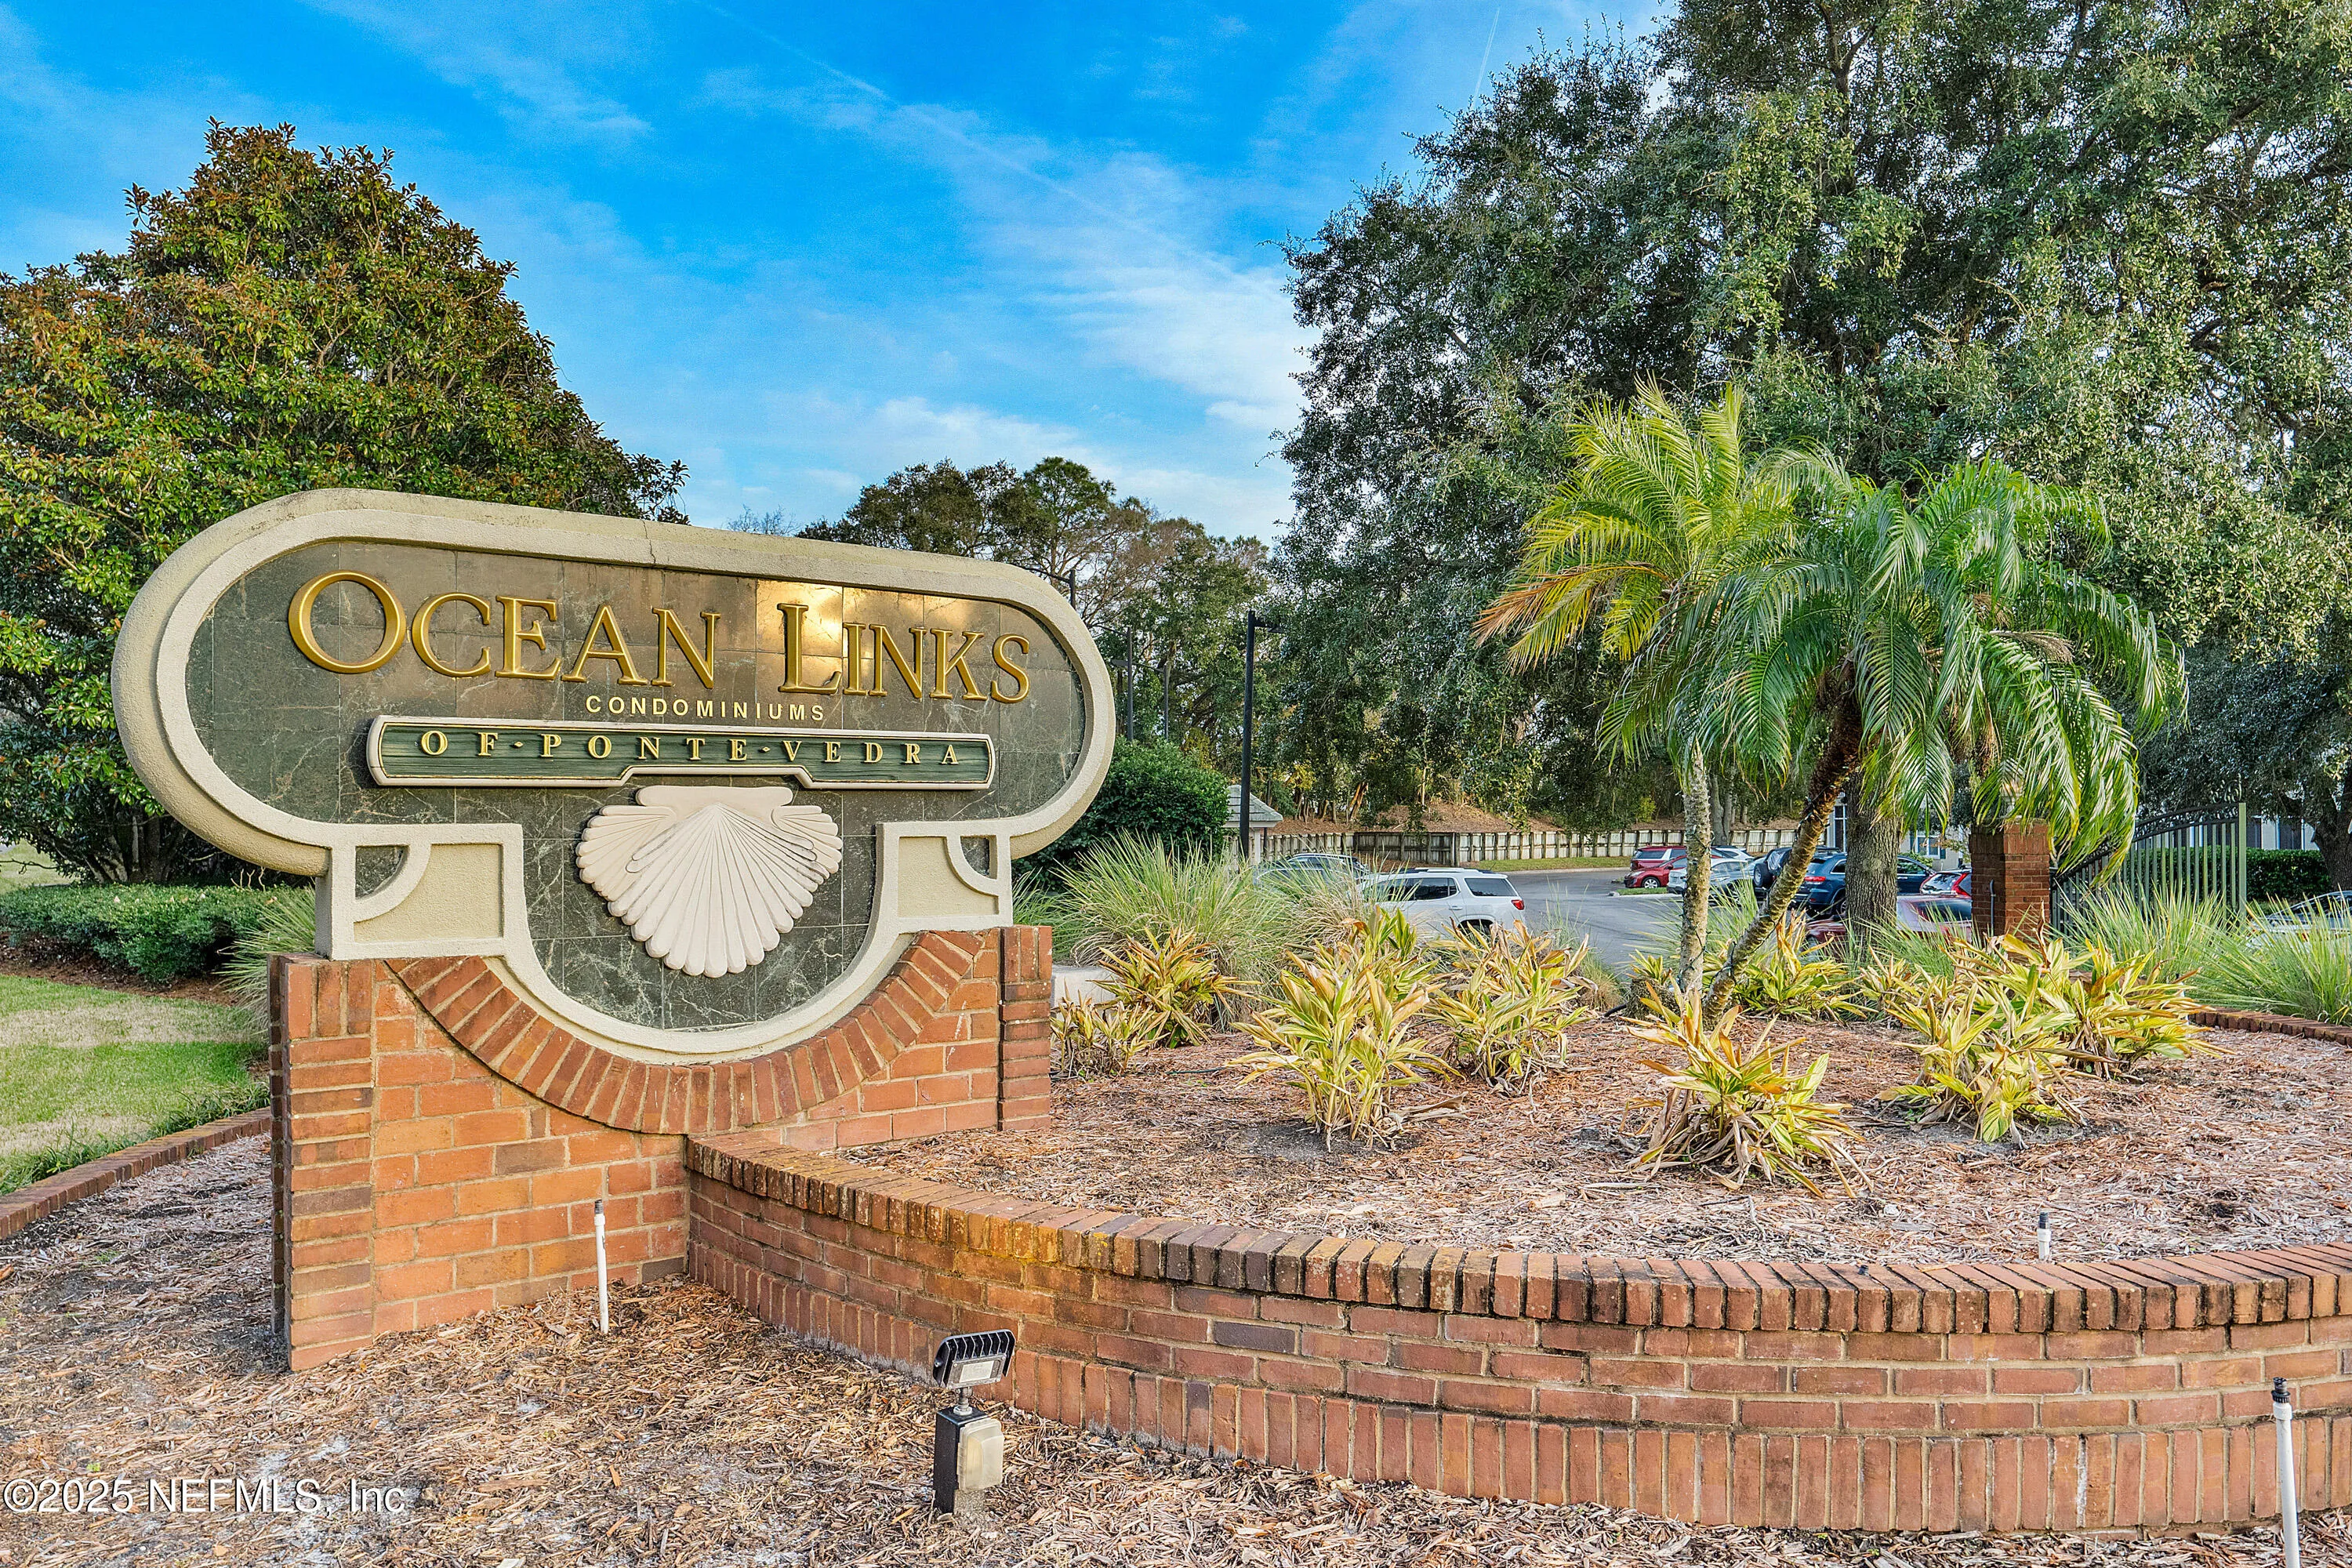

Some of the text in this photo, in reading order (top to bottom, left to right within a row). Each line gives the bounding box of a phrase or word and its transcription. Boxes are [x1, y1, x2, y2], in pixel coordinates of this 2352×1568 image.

[288, 570, 1030, 703] OCEAN LINKS
[586, 695, 824, 721] CONDOMINIUMS
